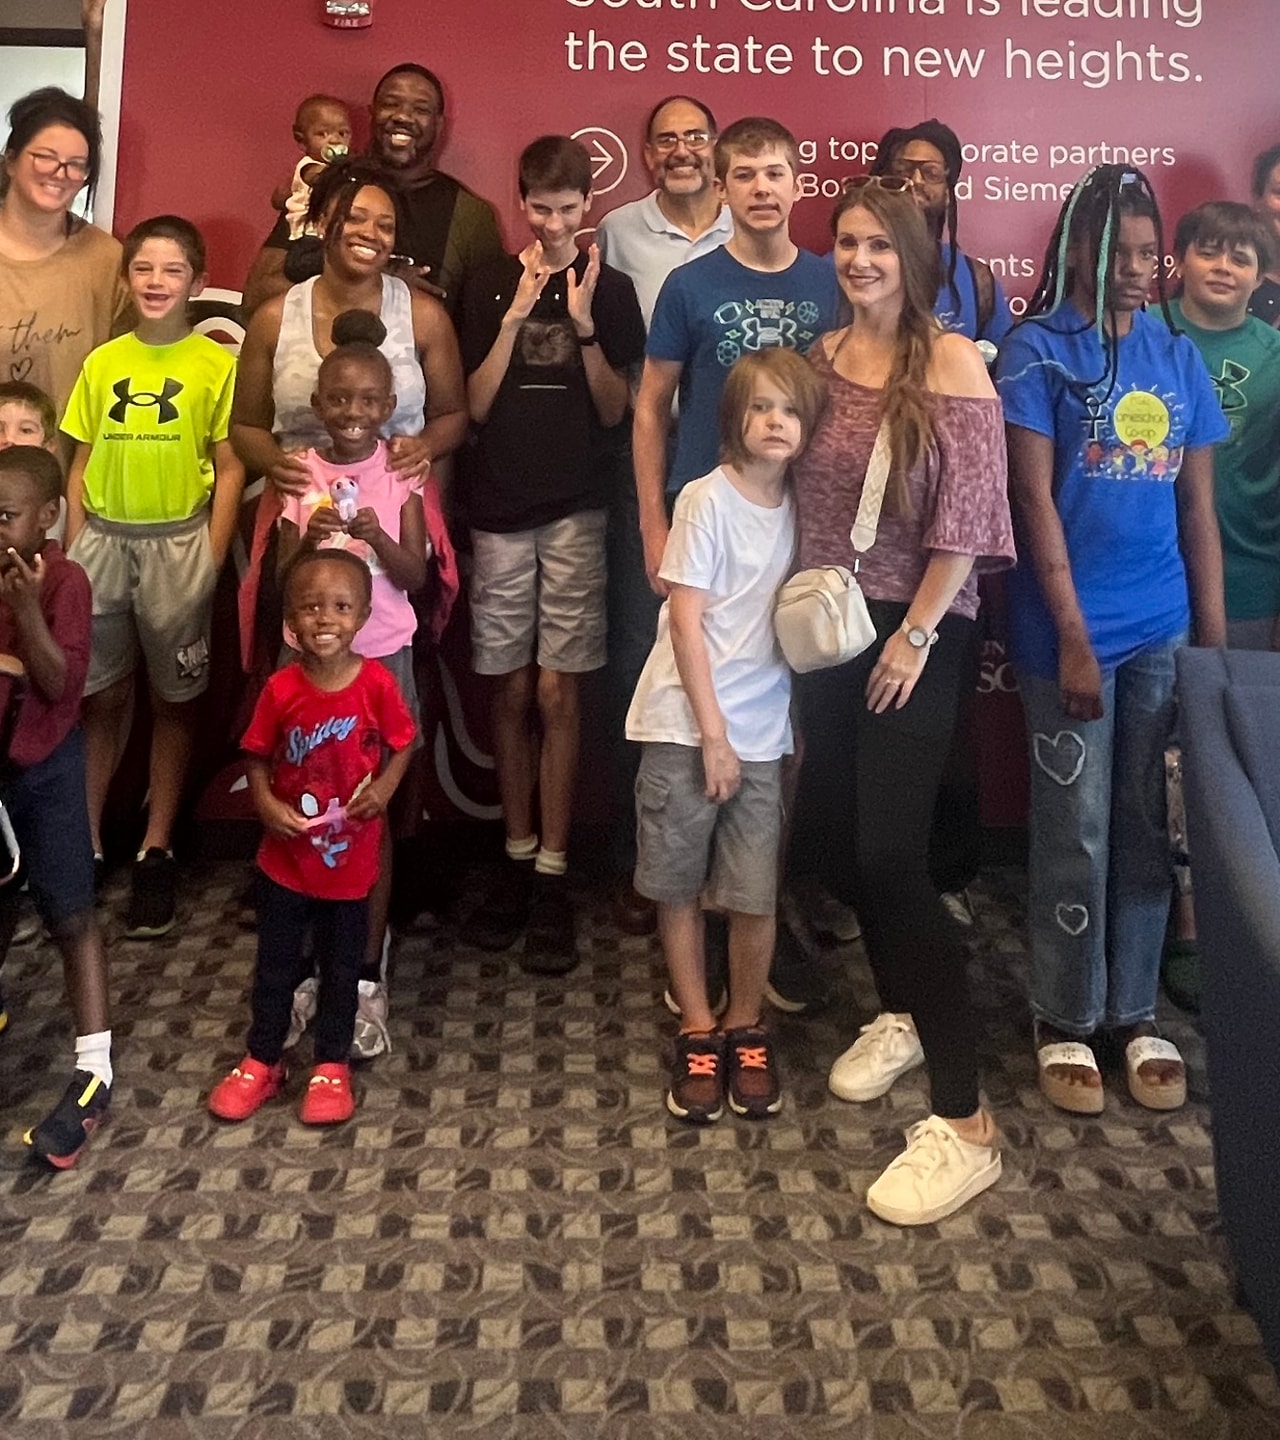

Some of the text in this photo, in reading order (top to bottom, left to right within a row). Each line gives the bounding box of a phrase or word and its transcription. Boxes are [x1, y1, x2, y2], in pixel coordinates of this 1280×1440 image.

[564, 29, 1203, 89] the state to new heights.
[961, 140, 1039, 164] orate
[1050, 141, 1177, 169] partners
[984, 176, 1075, 202] Sieme
[9, 312, 81, 354] them
[103, 433, 181, 441] UNDER ARMOUR
